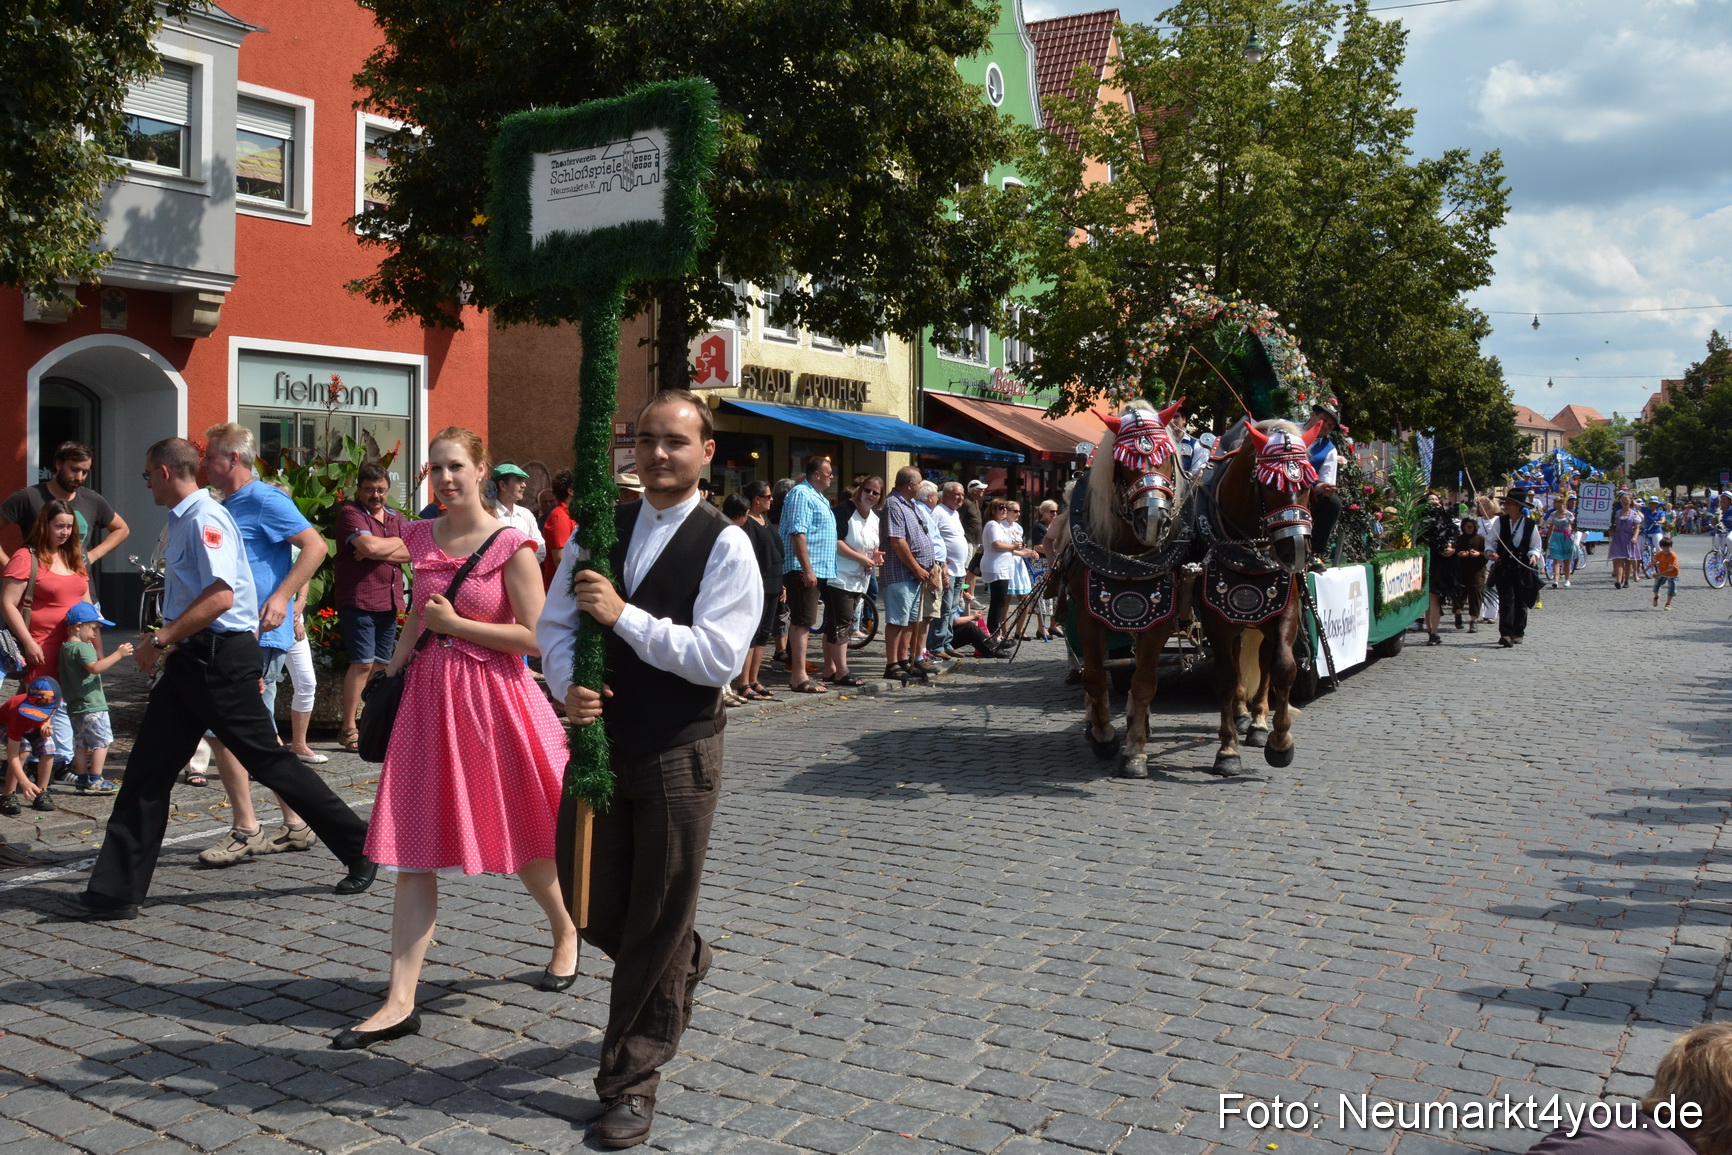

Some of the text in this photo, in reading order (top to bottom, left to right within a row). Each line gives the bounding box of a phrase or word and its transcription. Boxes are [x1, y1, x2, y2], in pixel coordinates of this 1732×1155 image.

[551, 152, 597, 170] Theaterverein
[550, 160, 622, 185] Schloßspiele
[550, 182, 585, 196] Neumarkt
[746, 364, 872, 403] STADT APOTHEKE
